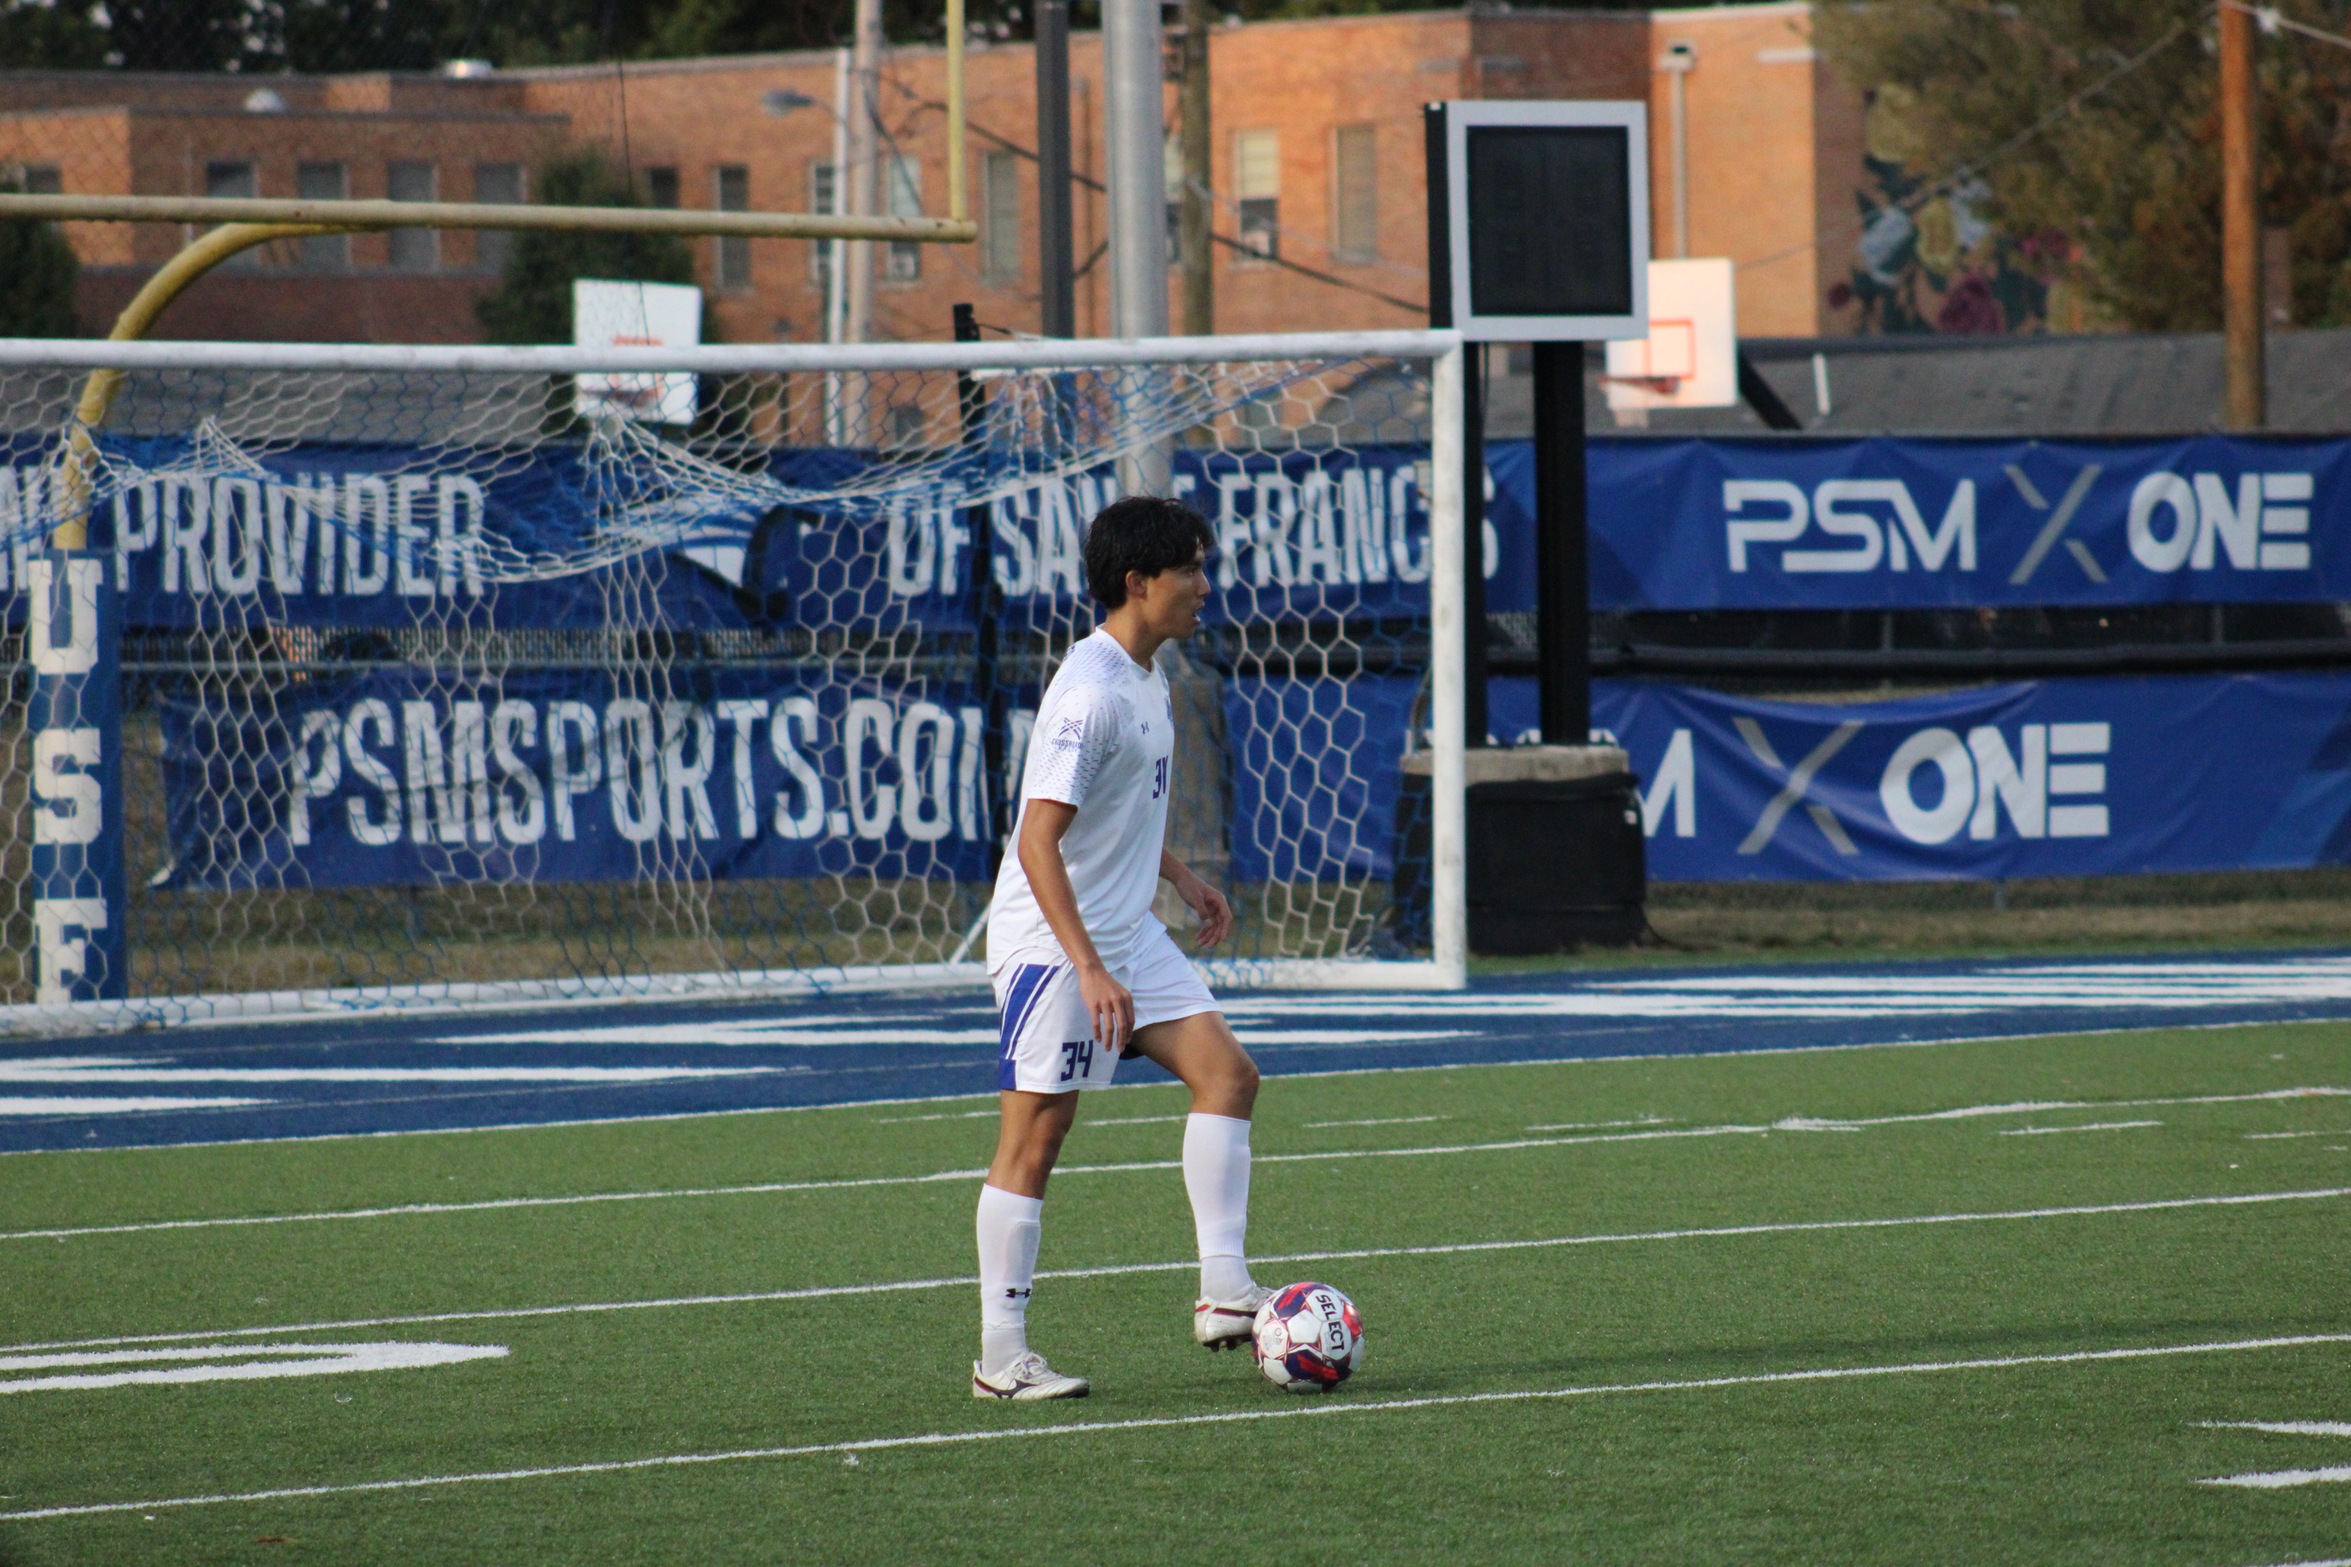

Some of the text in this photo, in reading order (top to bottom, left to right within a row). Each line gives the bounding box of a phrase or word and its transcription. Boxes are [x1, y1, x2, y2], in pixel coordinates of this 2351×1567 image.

[114, 474, 485, 596] PROVIDER
[1722, 479, 1976, 572] PSM
[2127, 471, 2314, 573] ONE
[1879, 722, 2110, 845] ONE
[1060, 1039, 1094, 1082] 34
[1315, 1294, 1345, 1351] SELECT
